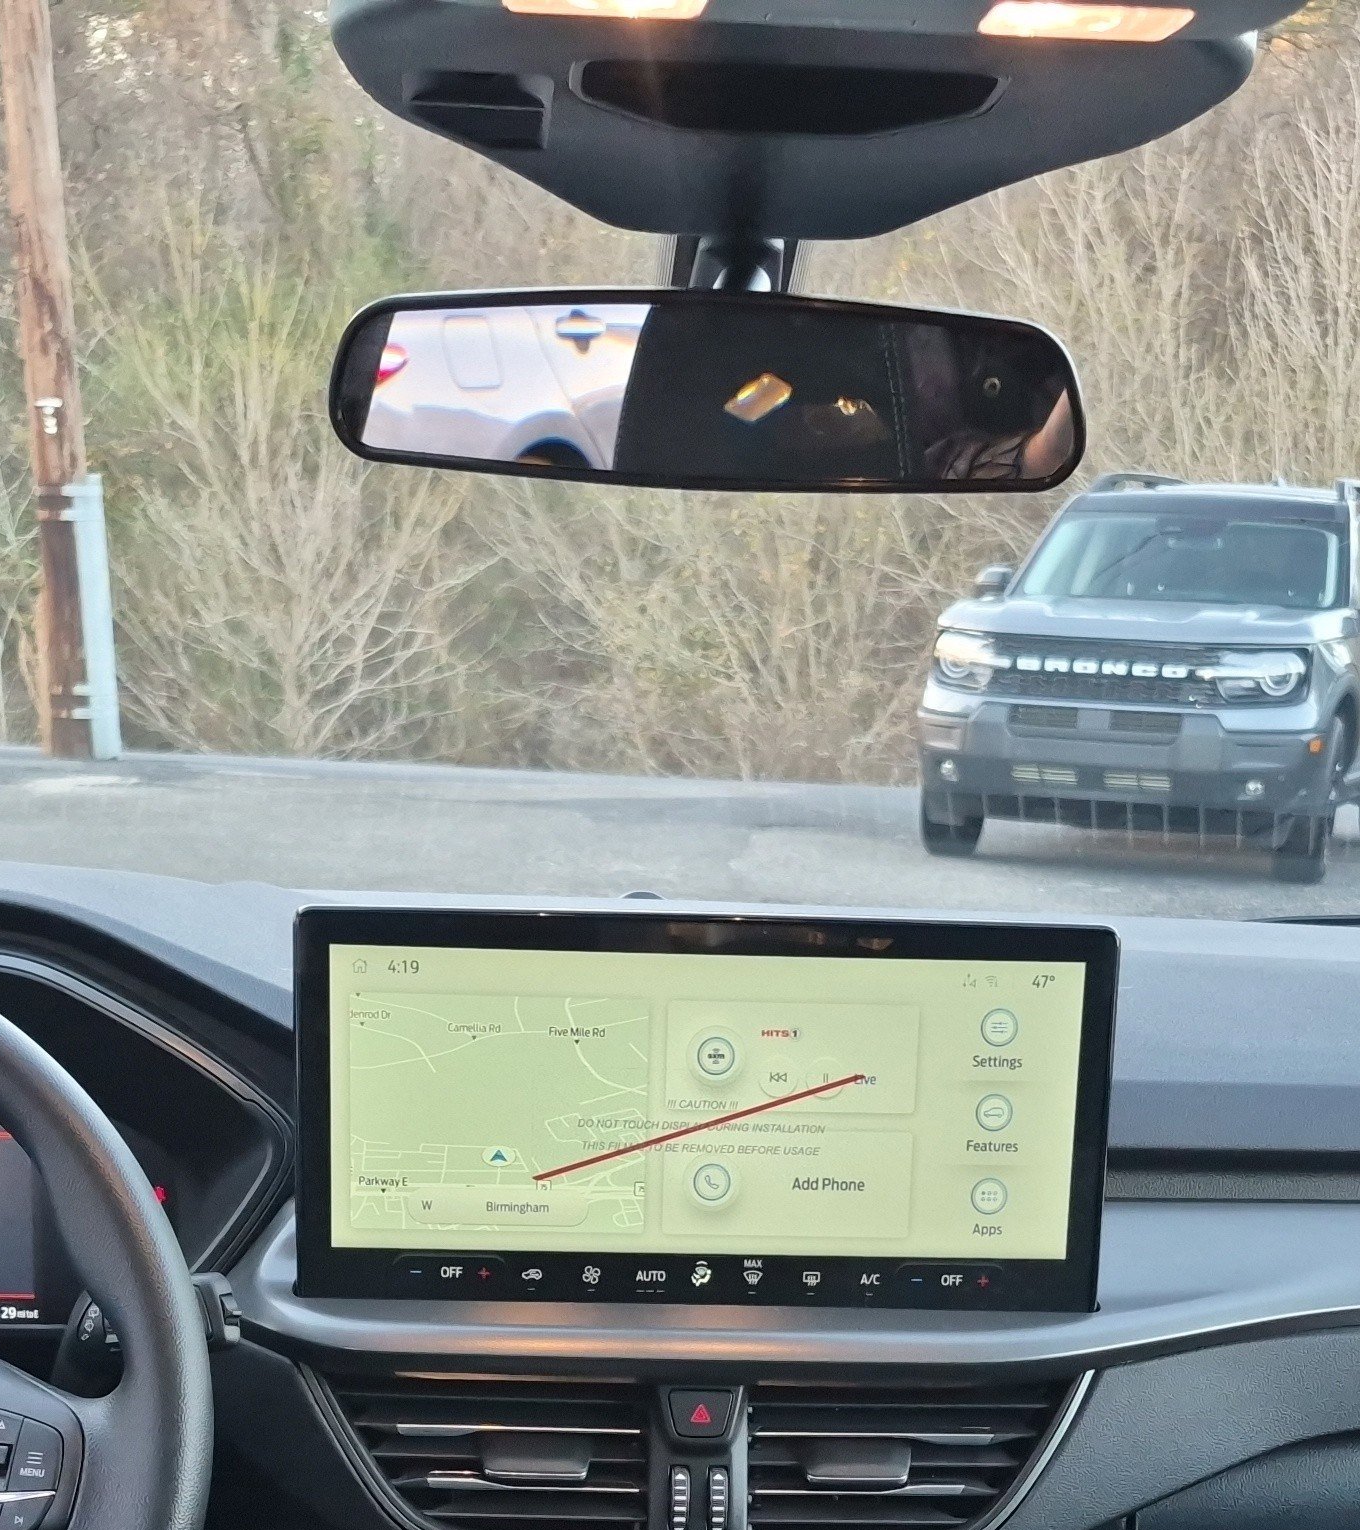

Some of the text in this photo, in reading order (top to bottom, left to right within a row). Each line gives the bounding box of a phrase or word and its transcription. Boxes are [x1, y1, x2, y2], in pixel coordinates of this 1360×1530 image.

[1016, 655, 1188, 679] BRONCO
[387, 960, 420, 974] 4:19
[1032, 975, 1056, 989] 47°
[381, 1010, 391, 1019] Dr
[448, 1022, 501, 1033] Camellia Rd
[549, 1027, 606, 1037] Five Mile Rd
[972, 1055, 1023, 1070] Settings
[679, 1100, 727, 1110] CAUTION
[578, 1119, 594, 1128] DO
[596, 1119, 619, 1128] NOT
[622, 1120, 659, 1130] TOUCH
[752, 1123, 826, 1134] INSTALLATION
[582, 1141, 605, 1150] THIS
[665, 1143, 679, 1152] BE
[681, 1144, 735, 1154] REMOVED
[737, 1145, 781, 1155] BEFORE
[783, 1146, 821, 1156] USAGE
[966, 1140, 1019, 1153] Features
[358, 1176, 408, 1189] Parkway E
[792, 1178, 865, 1191] Add Phone
[421, 1201, 433, 1211] W
[486, 1202, 549, 1215] Birmingham
[972, 1224, 1003, 1238] Apps
[743, 1259, 762, 1268] MAX
[440, 1266, 463, 1278] OFF
[636, 1270, 666, 1282] AUTO
[860, 1273, 881, 1284] A/C
[941, 1274, 963, 1286] OFF
[0, 1306, 17, 1320] 29
[20, 1467, 45, 1478] MENU
